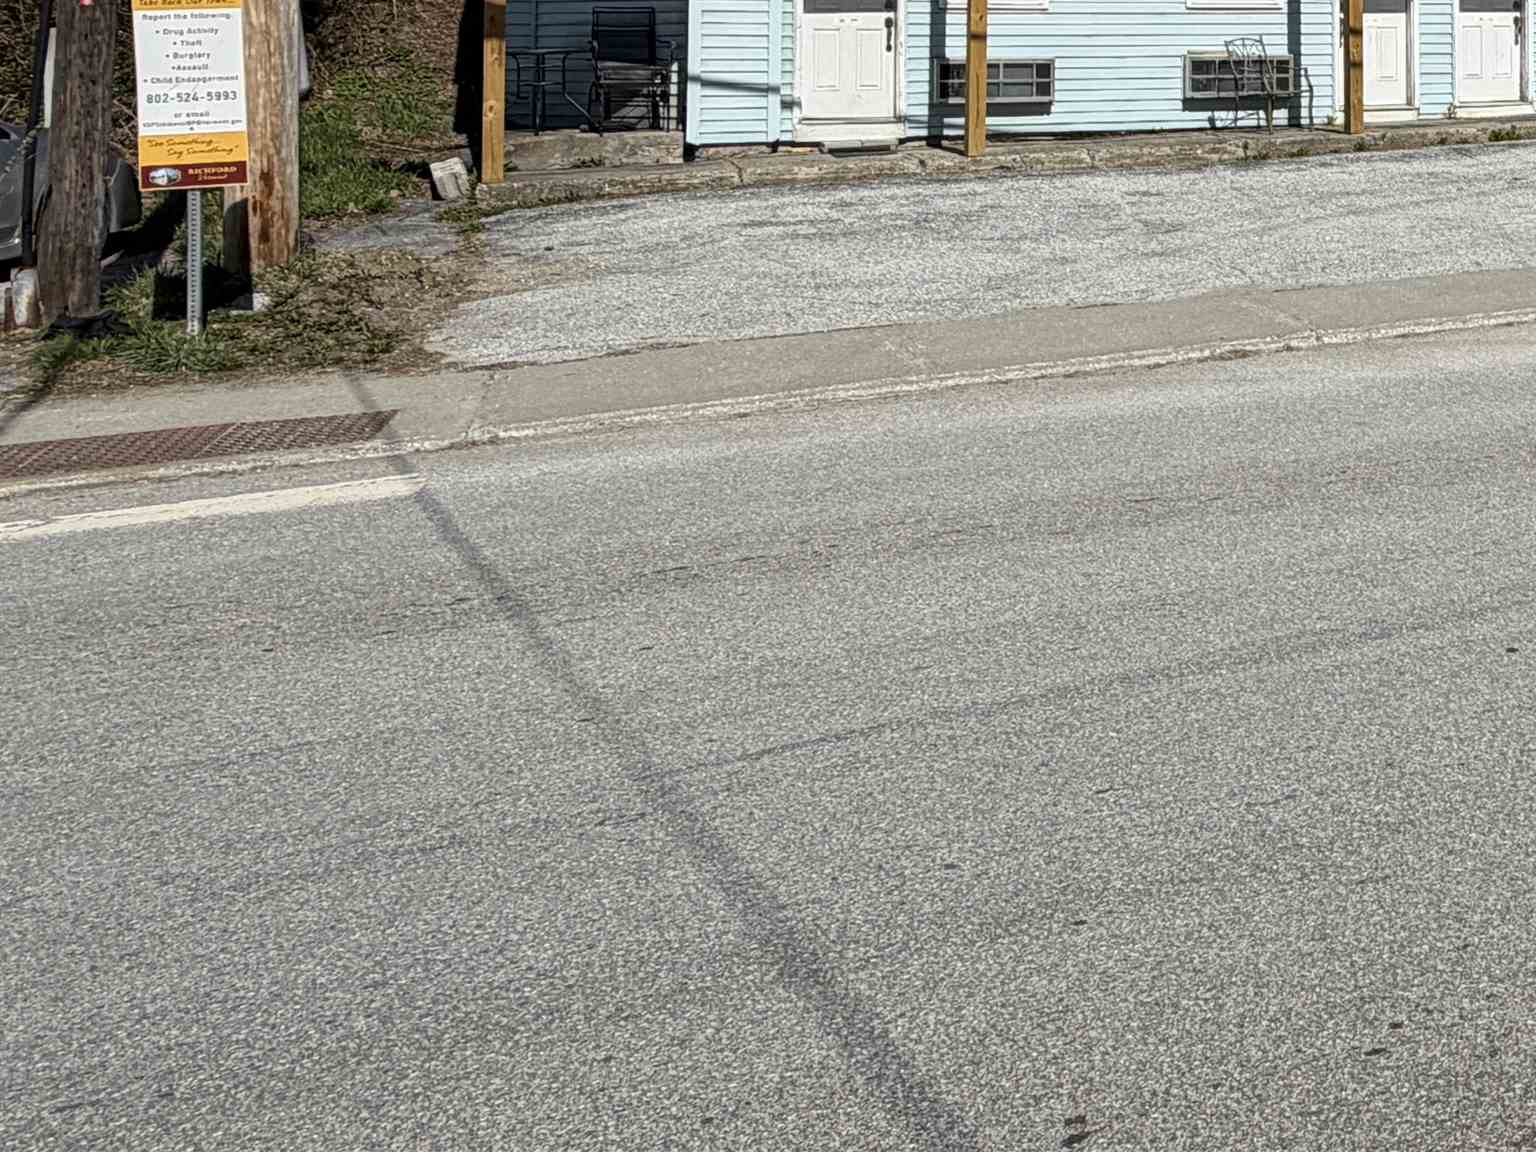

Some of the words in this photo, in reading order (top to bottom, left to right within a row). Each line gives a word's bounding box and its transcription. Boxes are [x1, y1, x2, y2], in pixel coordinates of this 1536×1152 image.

[142, 13, 171, 22] Report
[162, 28, 184, 36] Drug
[186, 27, 219, 35] Activity
[180, 39, 202, 47] Theft
[172, 51, 211, 60] Burglary
[150, 76, 173, 84] Child
[175, 74, 239, 84] Endangerment
[146, 90, 238, 104] 802-524-5993
